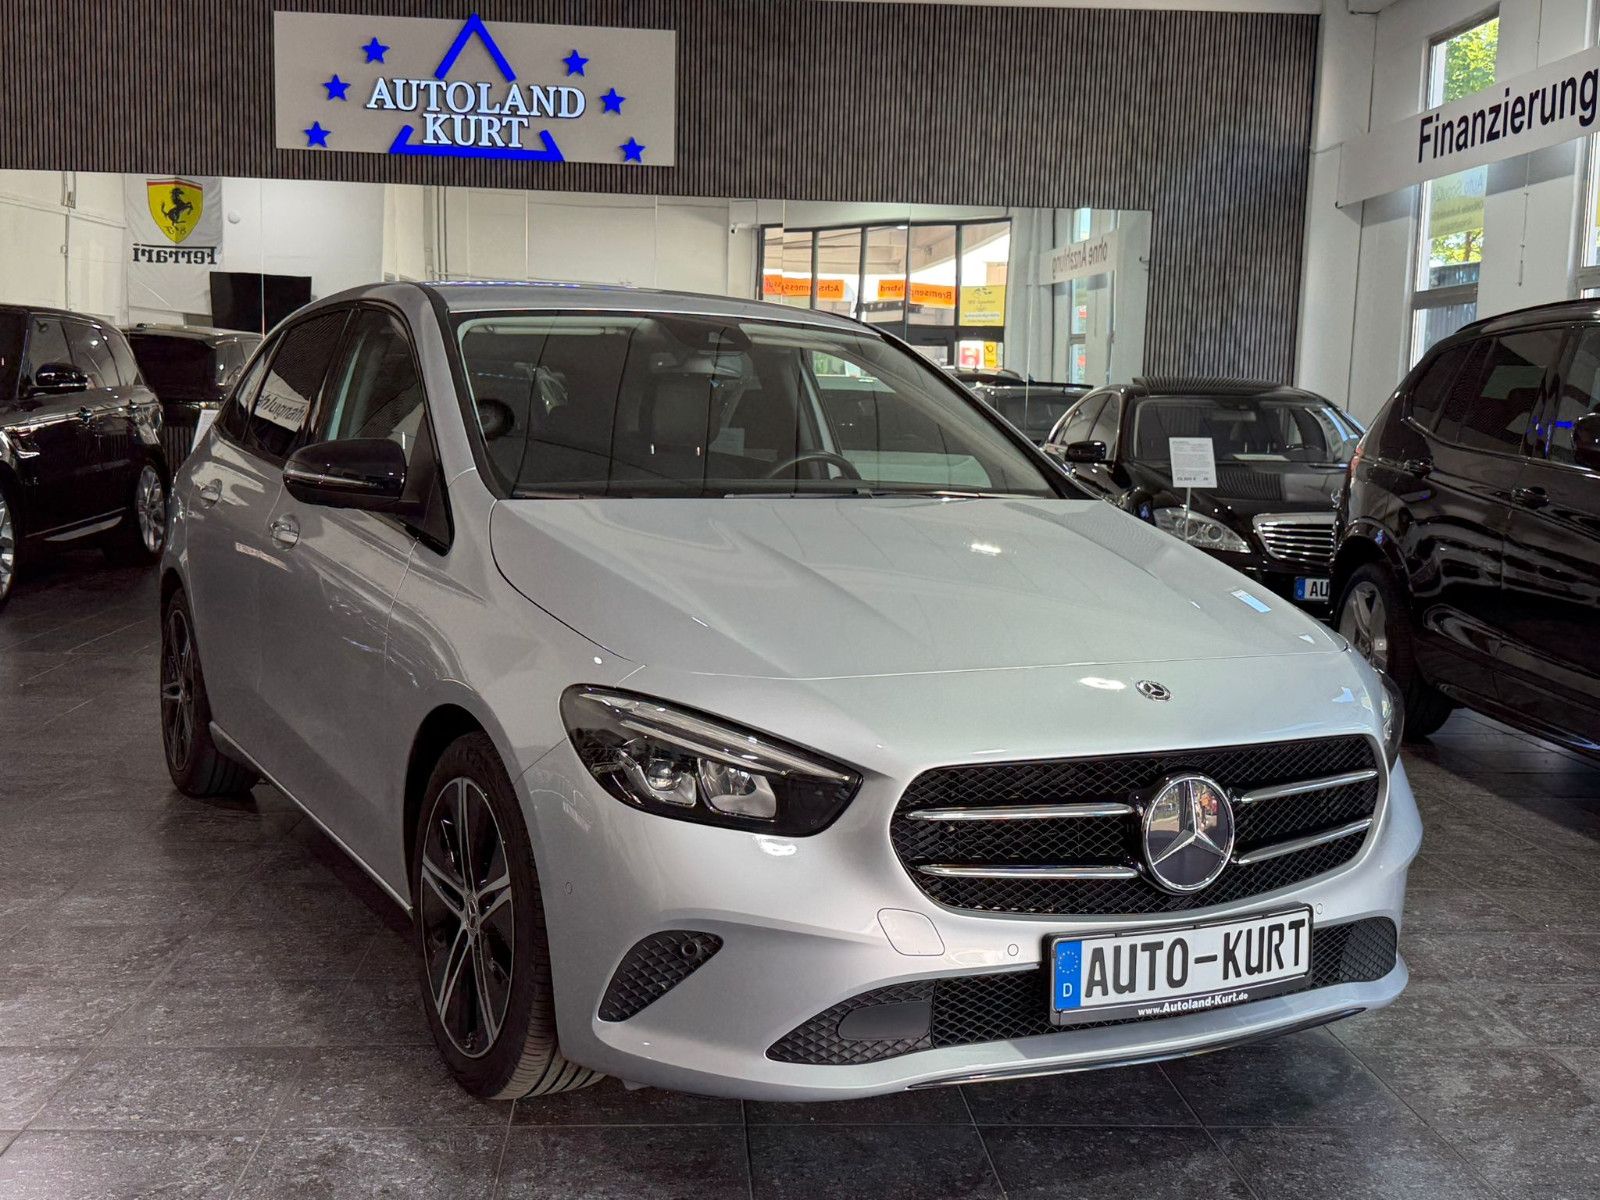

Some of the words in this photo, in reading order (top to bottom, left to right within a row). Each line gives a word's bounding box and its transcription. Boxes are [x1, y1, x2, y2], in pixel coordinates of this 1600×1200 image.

[366, 77, 586, 119] AUTOLAND
[1418, 68, 1599, 163] Finanzierung
[422, 112, 529, 149] KURT
[1062, 982, 1073, 998] D
[1084, 918, 1307, 998] AUTO-KURT
[1137, 991, 1249, 1016] www.Autoland-Kurt.de
